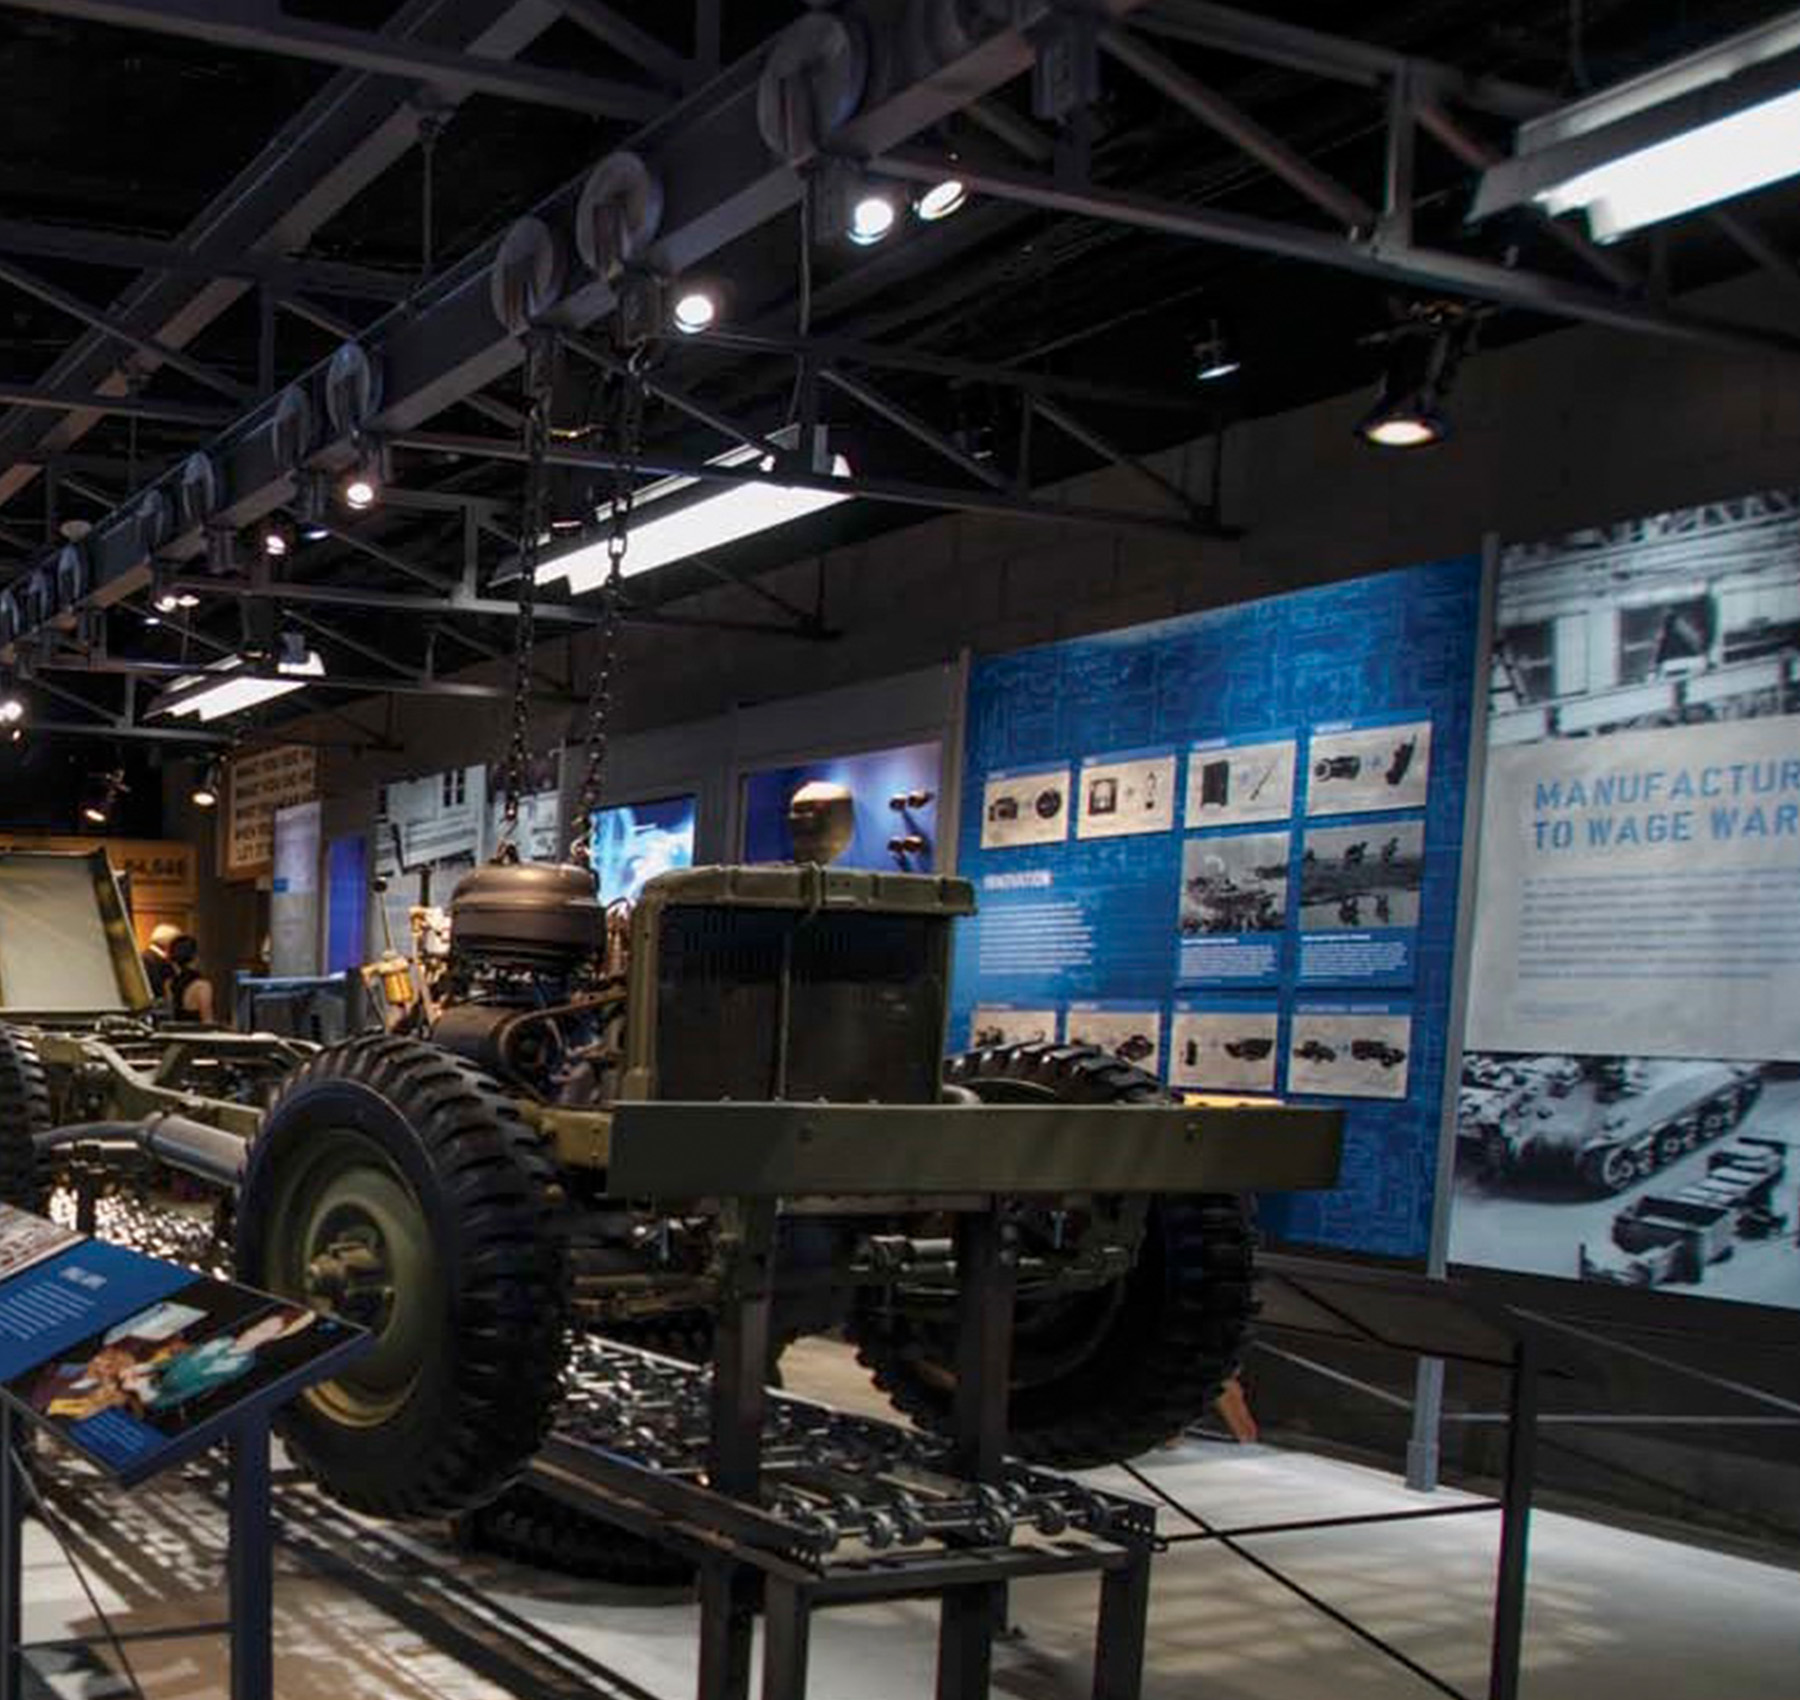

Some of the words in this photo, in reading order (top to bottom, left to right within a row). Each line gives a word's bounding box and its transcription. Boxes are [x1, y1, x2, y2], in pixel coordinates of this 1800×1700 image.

[1536, 759, 1800, 811] MANUFACTUR
[1534, 819, 1574, 851] TO
[1588, 810, 1695, 847] WAGE
[1710, 802, 1800, 841] WAR
